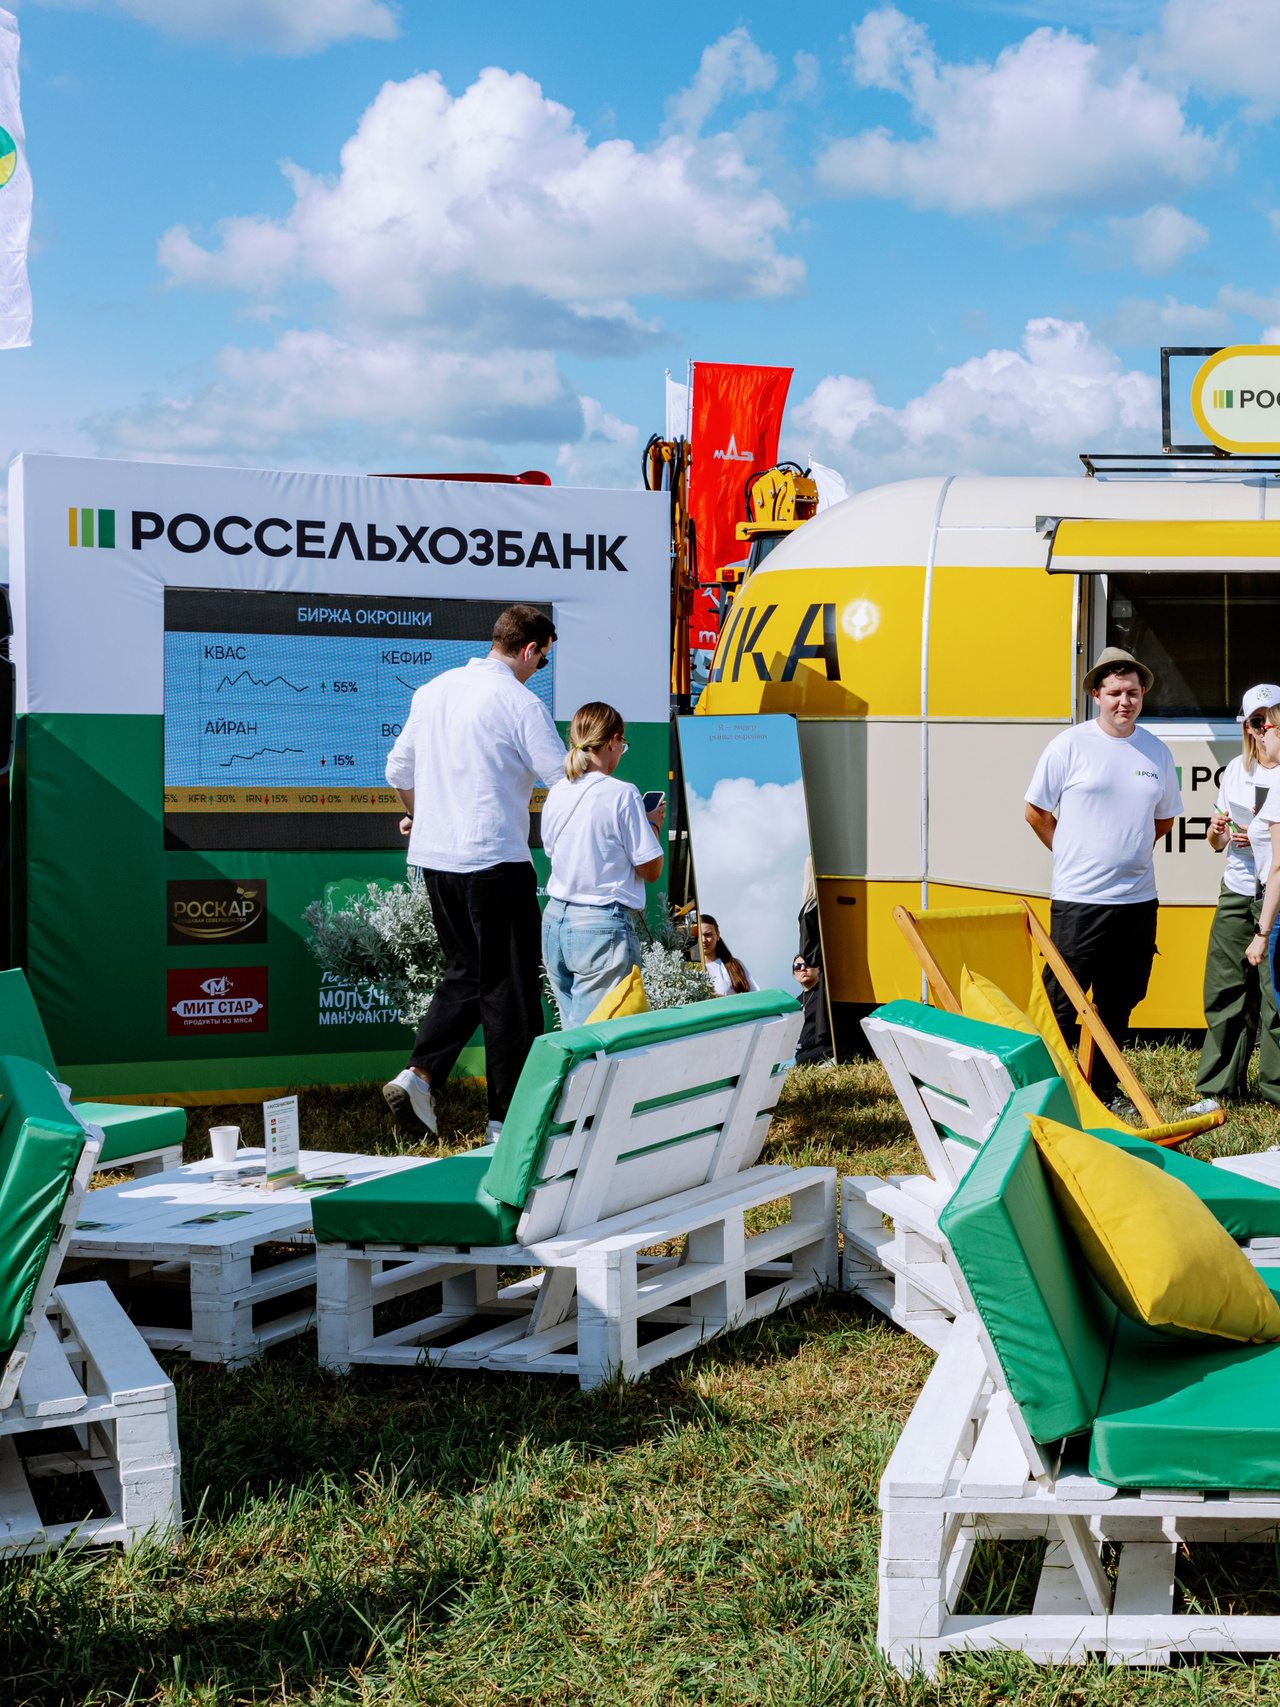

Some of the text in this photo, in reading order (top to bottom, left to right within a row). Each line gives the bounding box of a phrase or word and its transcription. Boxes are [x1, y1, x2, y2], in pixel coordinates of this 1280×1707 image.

[131, 510, 629, 572] РОССЕЛЬХОЗБАНК
[297, 607, 432, 626] БИРЖА ОКРОШКИ
[205, 646, 247, 660] КВАС
[381, 651, 433, 665] КЕФИР
[333, 682, 358, 693] 55%
[204, 718, 258, 735] АЙРАН
[333, 755, 355, 766] 15%
[188, 794, 206, 803] KFR
[216, 794, 236, 803] 30%
[246, 794, 262, 803] IRN
[271, 794, 288, 803] 15%
[299, 794, 318, 803] VOD
[327, 794, 341, 803] 0%
[350, 794, 368, 803] KVS
[378, 794, 397, 803] 55%
[173, 900, 255, 918] РОСКАР
[183, 1000, 254, 1015] МИТ СТАР
[184, 1018, 221, 1026] ПРОДУКТЫ
